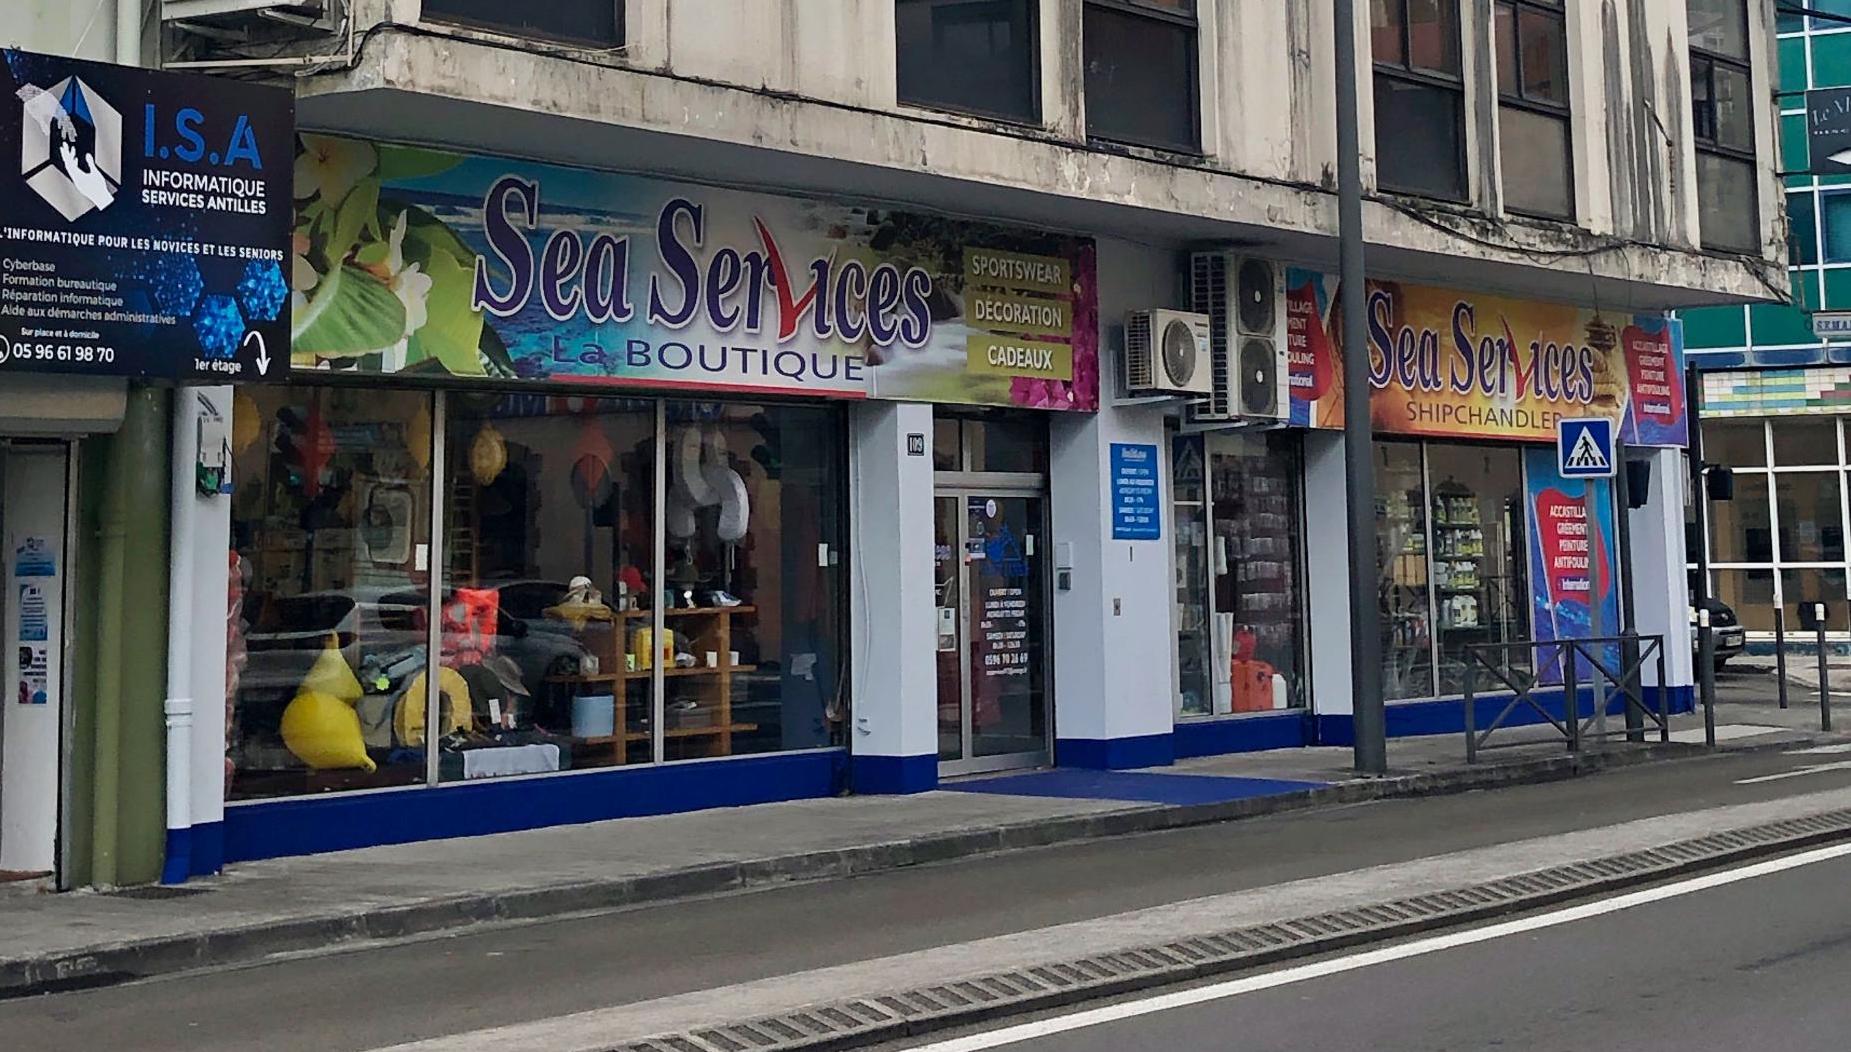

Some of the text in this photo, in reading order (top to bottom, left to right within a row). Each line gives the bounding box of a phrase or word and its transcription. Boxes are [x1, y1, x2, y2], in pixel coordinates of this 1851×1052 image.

[144, 103, 263, 170] I.S.A
[143, 168, 266, 198] INFORMATIQUE
[141, 188, 267, 215] SERVICES ANTILLES
[98, 234, 128, 248] POUR
[131, 238, 150, 250] LES
[153, 239, 200, 254] NOVICES
[203, 244, 215, 255] ET
[218, 246, 236, 257] LES
[239, 247, 284, 261] SENIORS
[471, 173, 934, 349] Sea Services
[2, 258, 56, 272] Cyberbase
[972, 255, 1062, 284] SPORTSWEAR
[2, 273, 117, 292] Formation bureautique
[2, 288, 124, 307] Réparation informatique
[1, 304, 176, 325] Aide aux démarches administratives
[975, 295, 1062, 328] DÉCORATION
[12, 343, 115, 363] 05 96 61 98 70
[553, 335, 866, 383] La BOUTIQUE
[987, 345, 1053, 370] CADEAUX
[1366, 290, 1595, 404] Sea Services
[194, 358, 242, 374] 1er étage
[909, 436, 923, 452] 109
